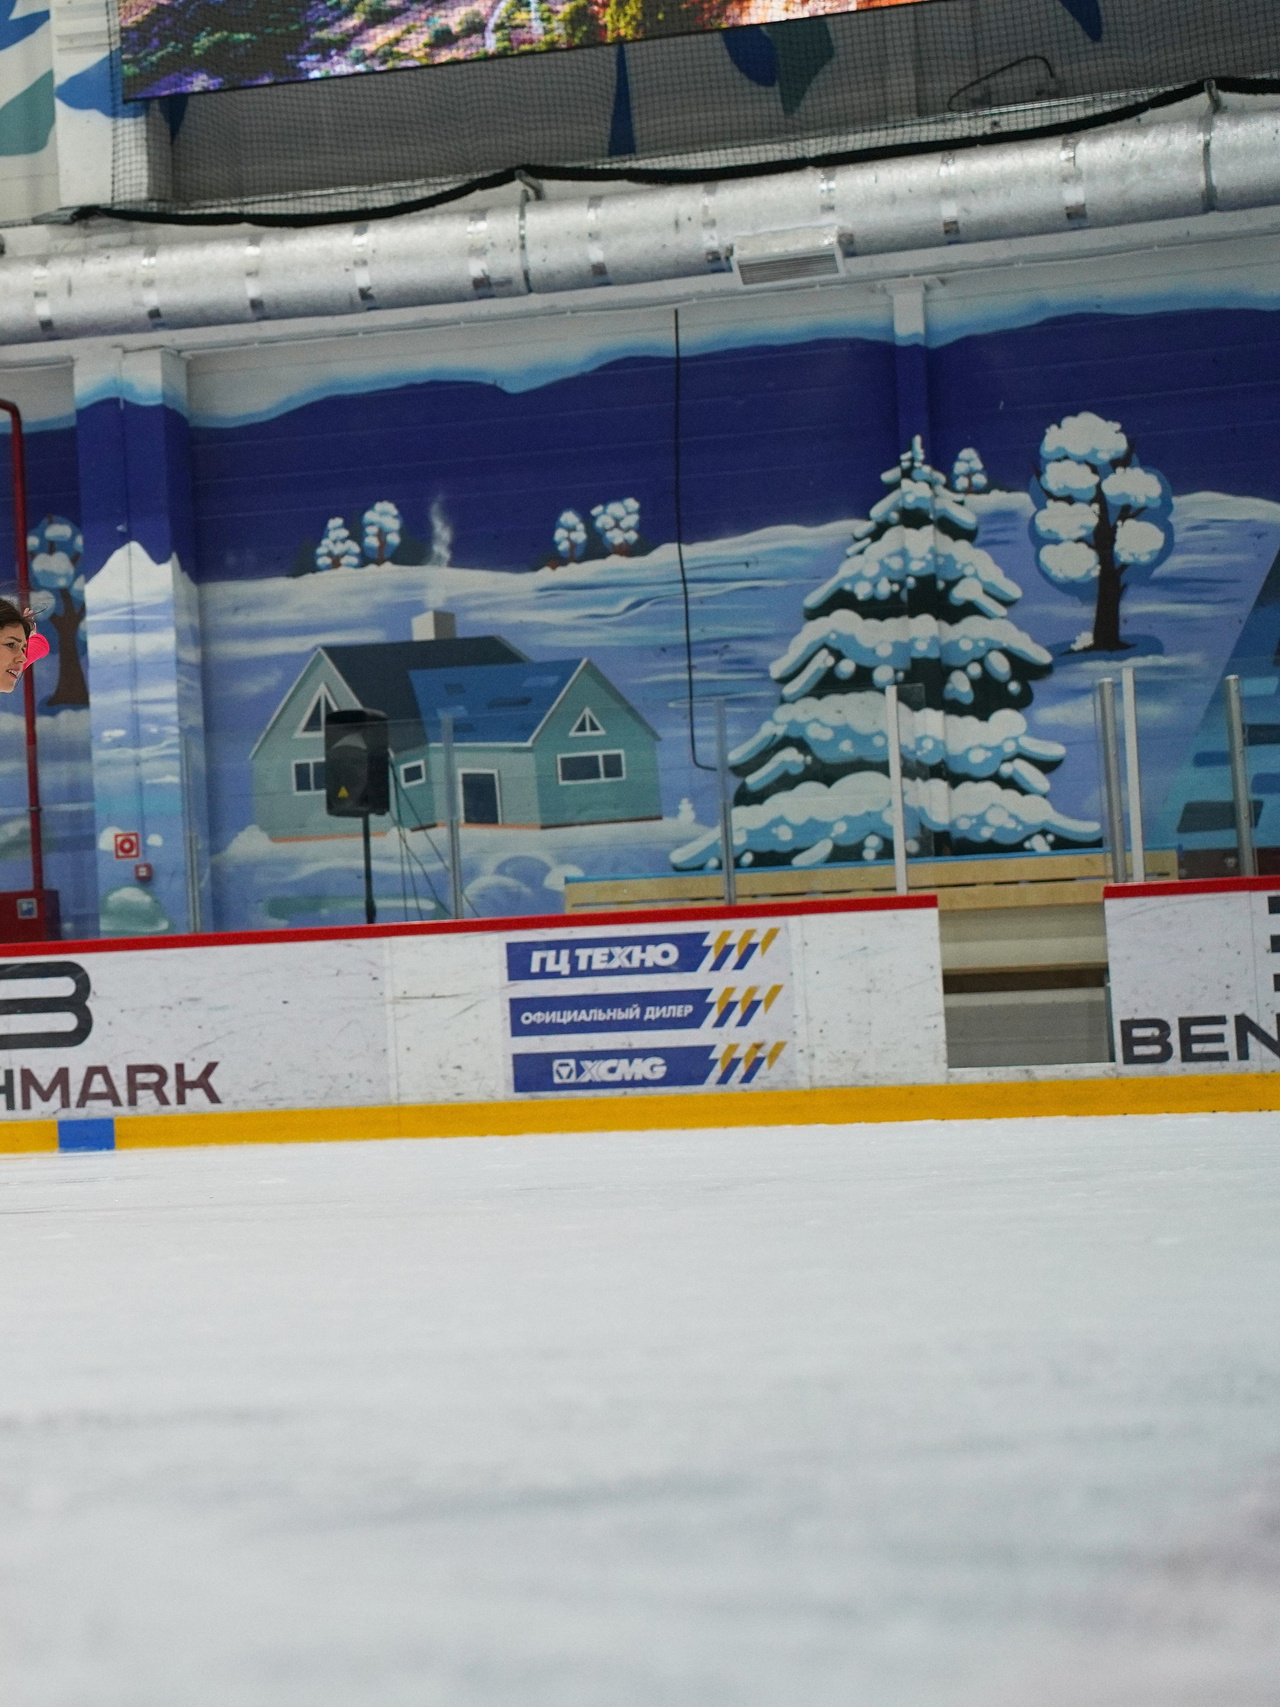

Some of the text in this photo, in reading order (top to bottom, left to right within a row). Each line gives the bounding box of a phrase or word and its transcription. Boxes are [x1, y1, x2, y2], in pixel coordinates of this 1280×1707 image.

[530, 942, 680, 976] ГЦ ТЕХНО
[520, 1003, 694, 1026] ОФИЦИАЛЬНЫЙ ДИЛЕР
[579, 1056, 668, 1084] XCMG
